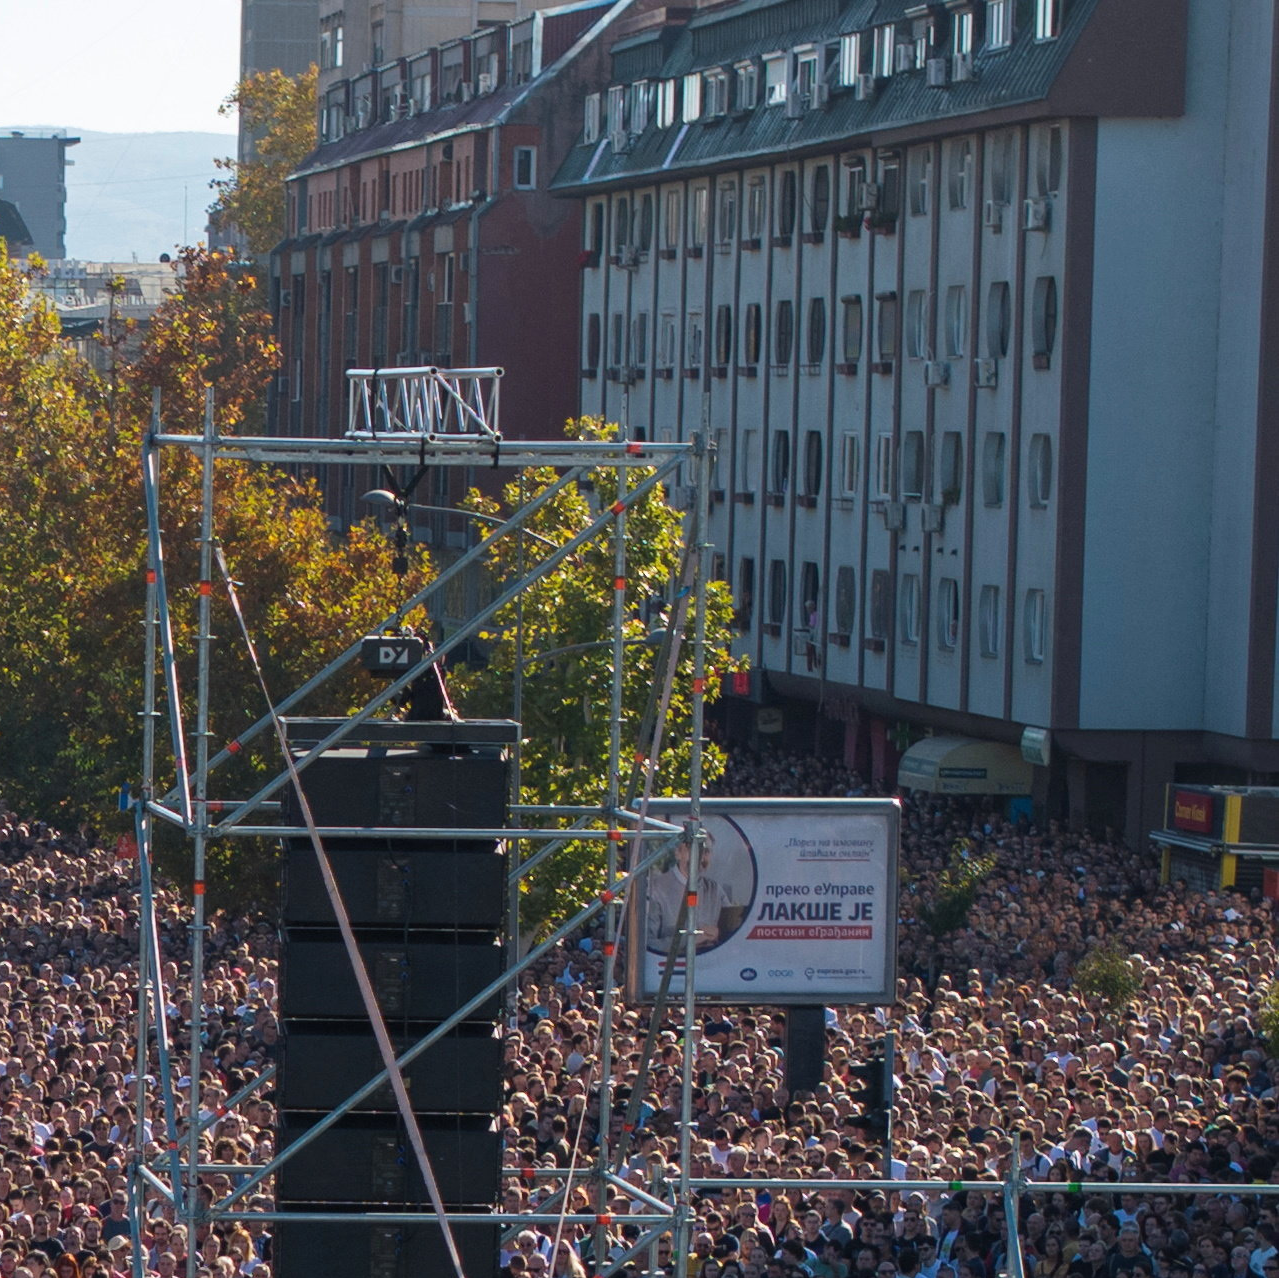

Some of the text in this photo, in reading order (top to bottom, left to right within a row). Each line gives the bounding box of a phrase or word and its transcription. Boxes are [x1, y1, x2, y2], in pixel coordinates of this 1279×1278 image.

[765, 882, 875, 898] преко еУправе
[757, 902, 873, 921] ЛАКШЕ ЈЕ
[756, 928, 805, 936] постани
